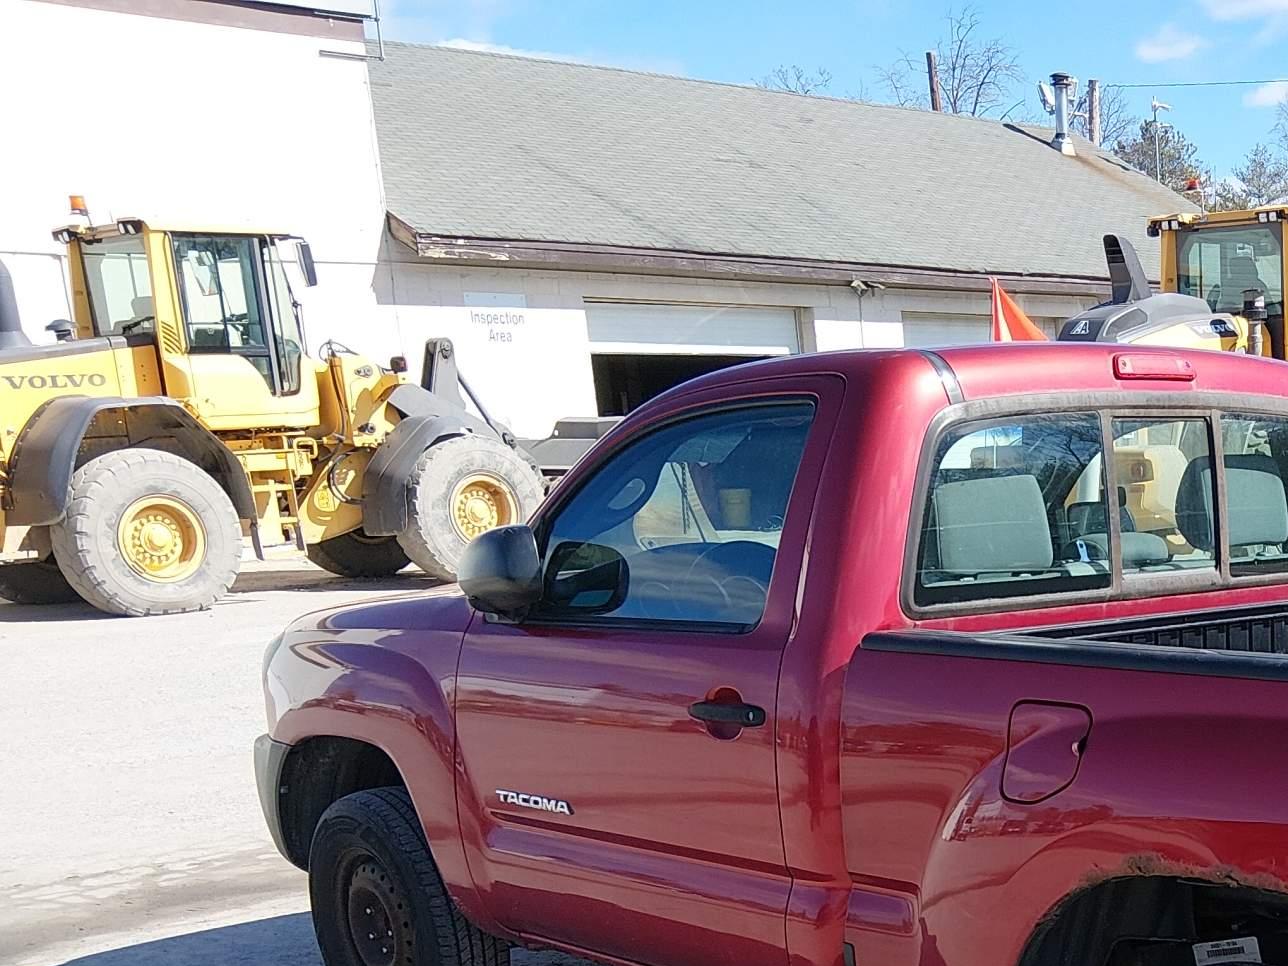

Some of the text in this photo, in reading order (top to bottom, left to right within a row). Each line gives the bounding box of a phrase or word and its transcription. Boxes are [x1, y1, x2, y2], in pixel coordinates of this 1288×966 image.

[470, 310, 525, 326] Inspection
[489, 328, 513, 342] Area
[1, 373, 106, 389] VOLVO
[495, 788, 573, 816] TACOMA
